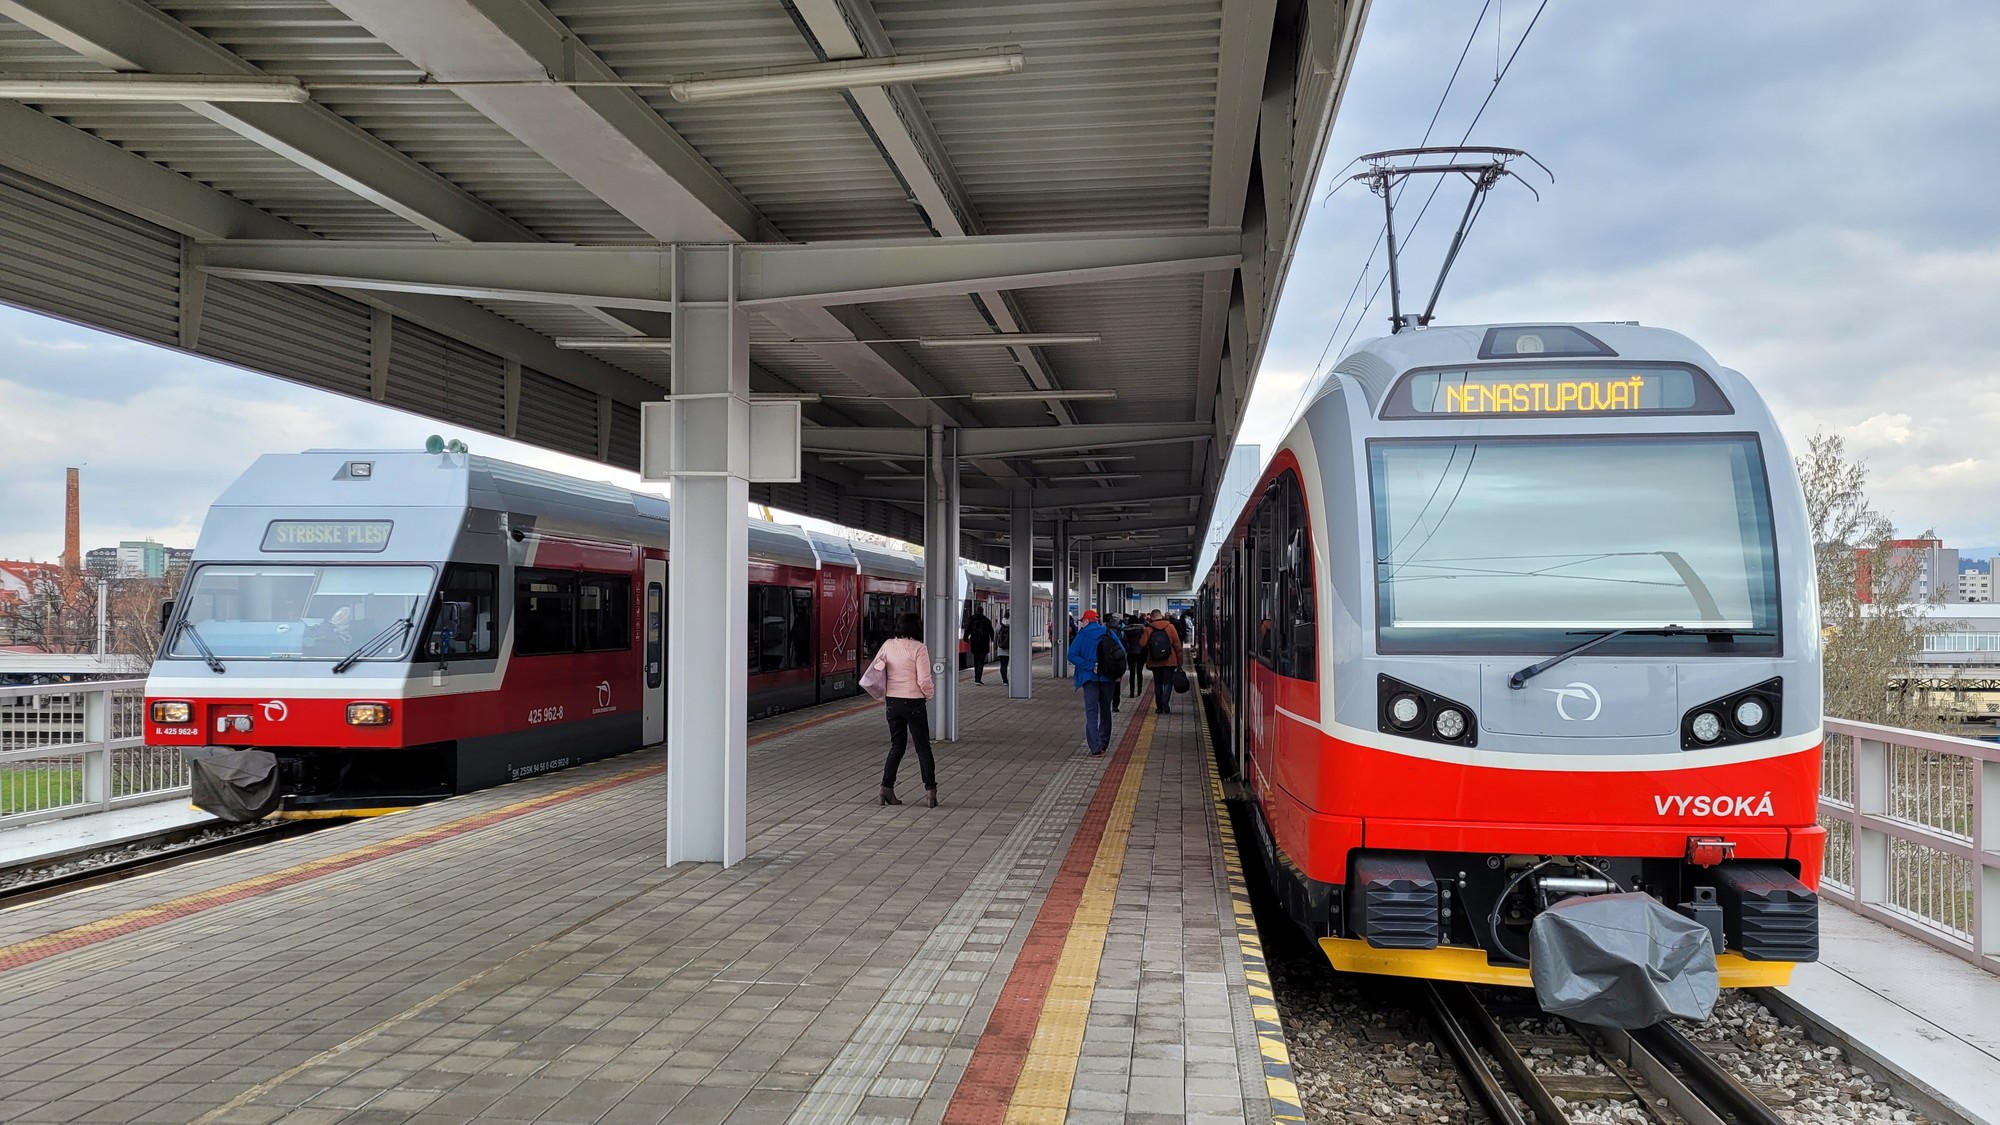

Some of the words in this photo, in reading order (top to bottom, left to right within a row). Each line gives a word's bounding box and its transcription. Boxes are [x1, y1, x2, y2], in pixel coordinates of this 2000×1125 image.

[1447, 376, 1644, 413] NENASTUPOVAŤ
[528, 708, 542, 724] 425
[543, 705, 564, 722] 962-8
[163, 727, 177, 735] 425
[178, 728, 198, 736] 962-8
[1654, 791, 1774, 817] VYSOKÁ
